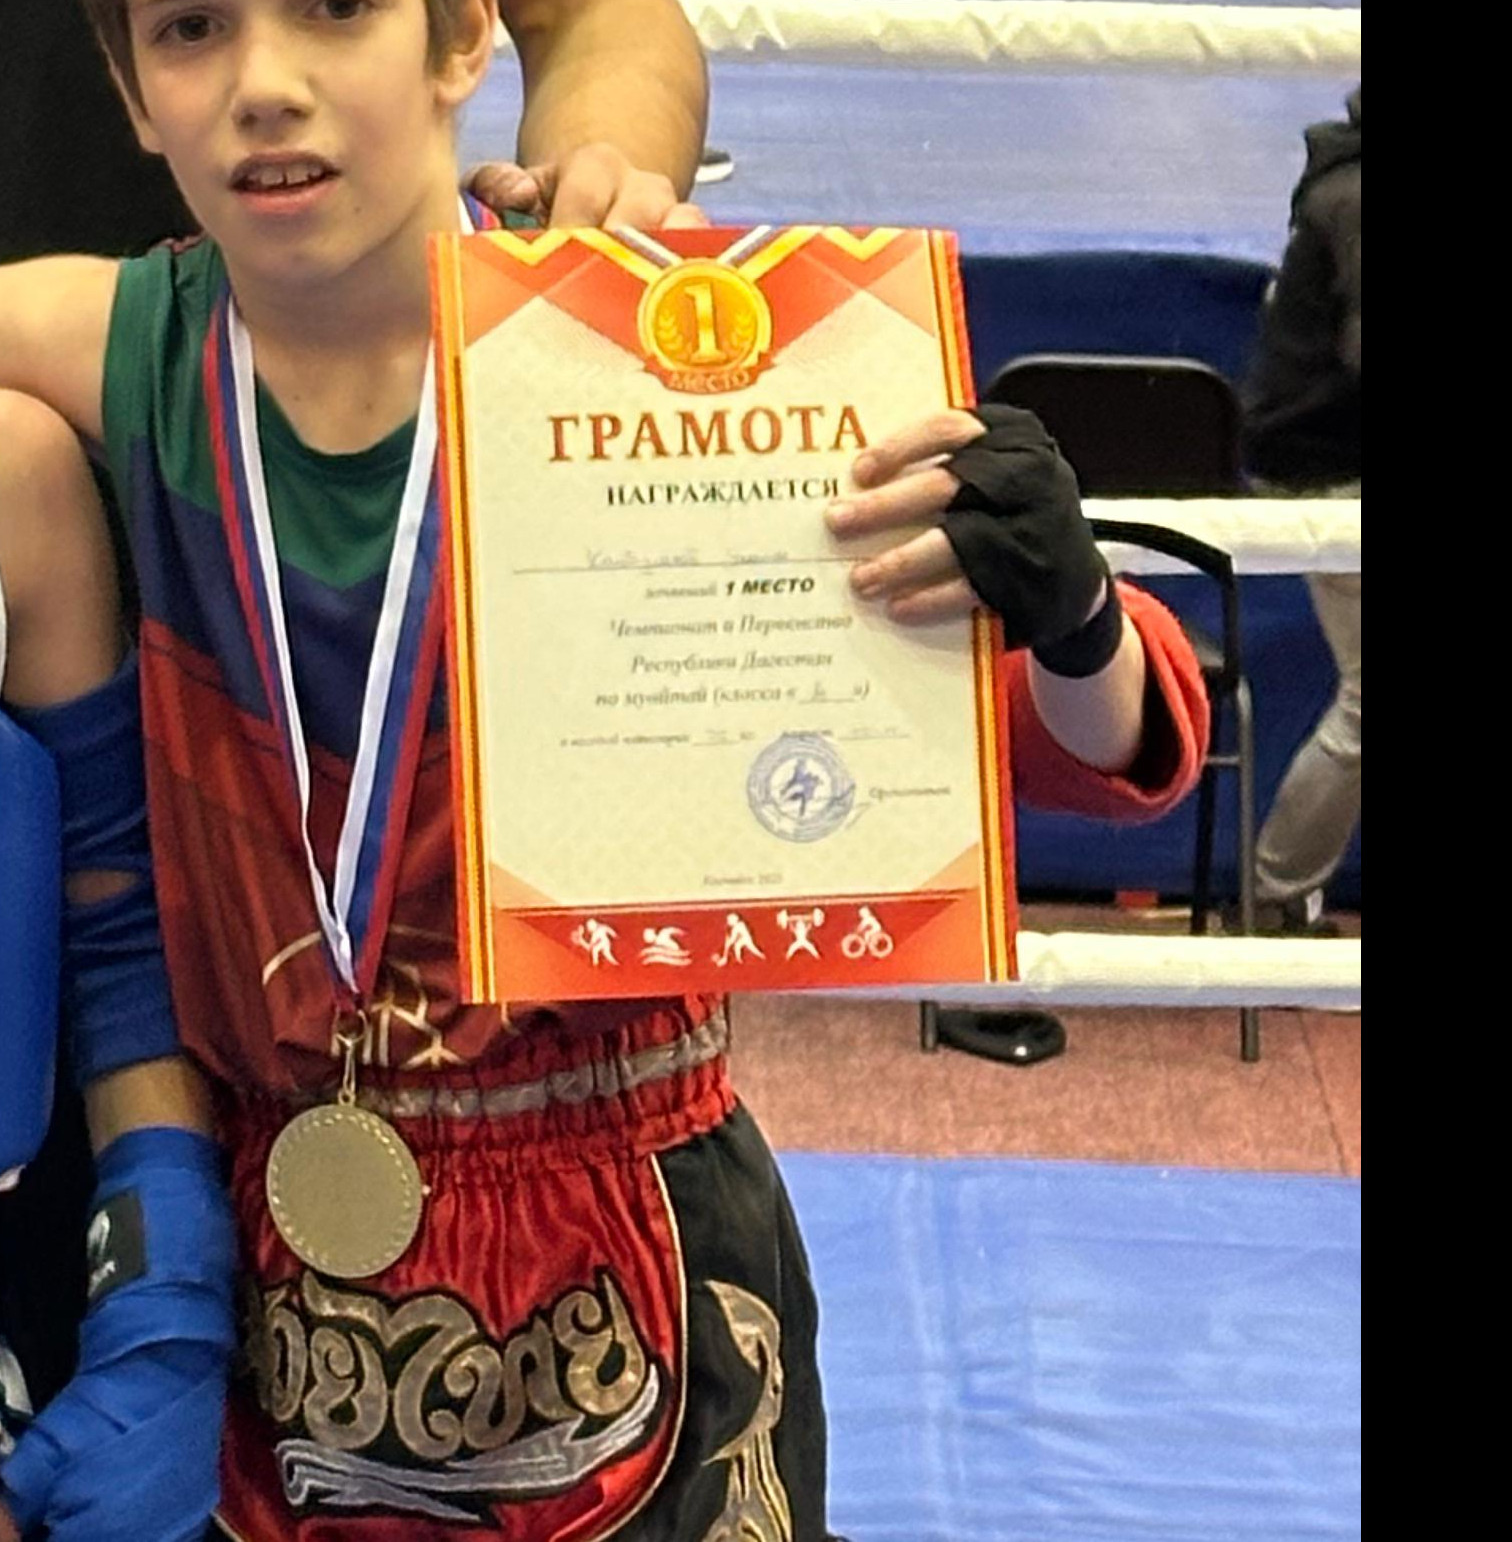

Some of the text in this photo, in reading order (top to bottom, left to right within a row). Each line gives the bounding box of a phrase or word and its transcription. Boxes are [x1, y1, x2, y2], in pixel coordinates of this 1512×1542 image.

[683, 283, 724, 360] 1
[548, 404, 870, 463] ГРАМОТА
[606, 478, 841, 507] НАГРАЖДАЕТСЯ
[725, 579, 735, 597] 1
[741, 577, 816, 596] МЕСТО
